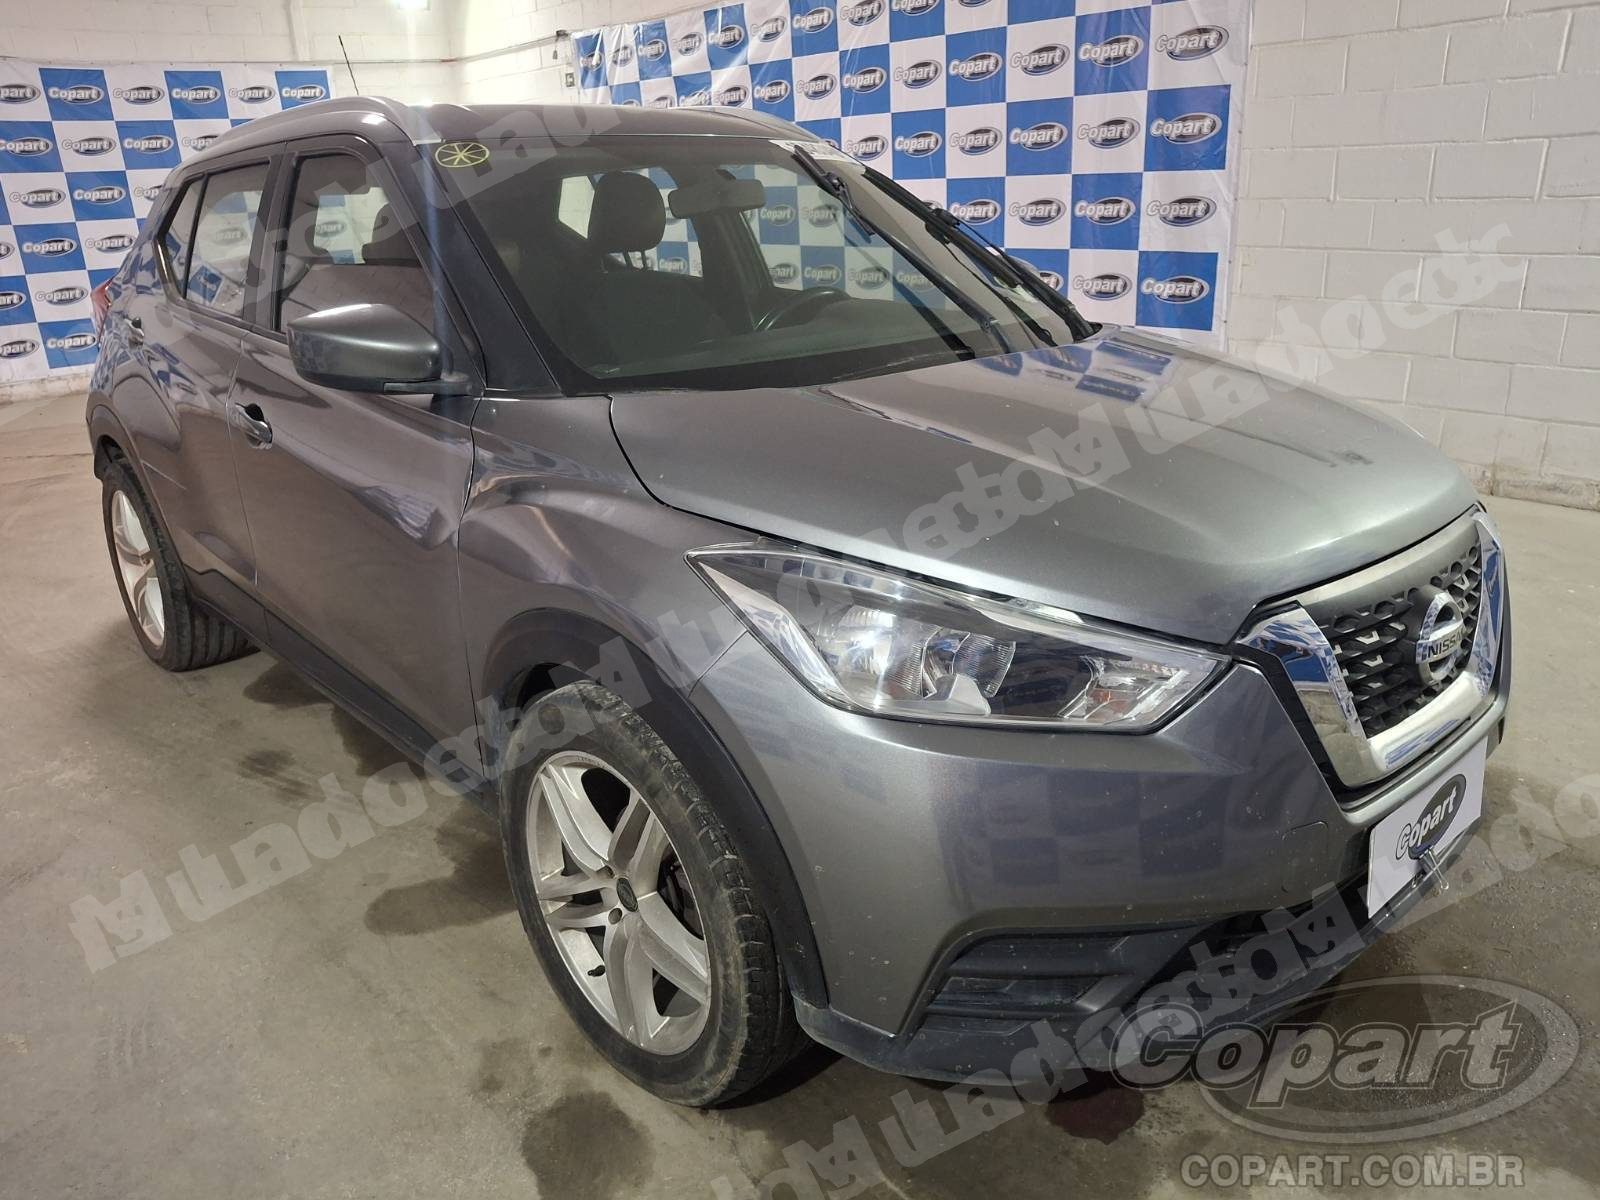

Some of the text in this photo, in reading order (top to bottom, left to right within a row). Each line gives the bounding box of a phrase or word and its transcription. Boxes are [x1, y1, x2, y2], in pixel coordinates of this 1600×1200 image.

[840, 1, 879, 21] Copart
[792, 11, 830, 30] Copart
[1155, 28, 1219, 53] Copart
[1010, 48, 1063, 71] Copart
[1079, 38, 1135, 63] Copart
[894, 62, 935, 84] Copart
[949, 54, 996, 78] Copart
[796, 76, 832, 95] Copart
[843, 69, 881, 88] Copart
[0, 87, 34, 99] part
[48, 86, 98, 100] Copart
[113, 88, 157, 101] Copart
[171, 87, 215, 101] Copart
[229, 87, 270, 100] Copart
[281, 86, 321, 98] Copart
[754, 82, 787, 100] Copart
[1009, 126, 1060, 146] Copart
[1078, 122, 1131, 143] Copart
[1151, 118, 1213, 140] Copart
[62, 139, 110, 152] Copart
[123, 138, 167, 150] Copart
[182, 137, 213, 149] Copa
[847, 138, 883, 155] Copart
[894, 135, 935, 153] Copart
[949, 131, 995, 152] Copart
[9, 192, 59, 205] Copart
[73, 189, 120, 202] Copart
[134, 187, 160, 199] Cop
[950, 203, 995, 220] Copart
[1008, 201, 1059, 220] Copart
[1074, 200, 1129, 219] Copart
[1146, 200, 1206, 220] Copart
[23, 241, 71, 254] Copart
[85, 238, 130, 250] Copart
[1072, 276, 1124, 298] Copart
[1141, 279, 1201, 300] Copart
[0, 294, 20, 305] art
[35, 290, 80, 303] Copart
[47, 336, 93, 350] Copart
[1396, 785, 1457, 860] Copart
